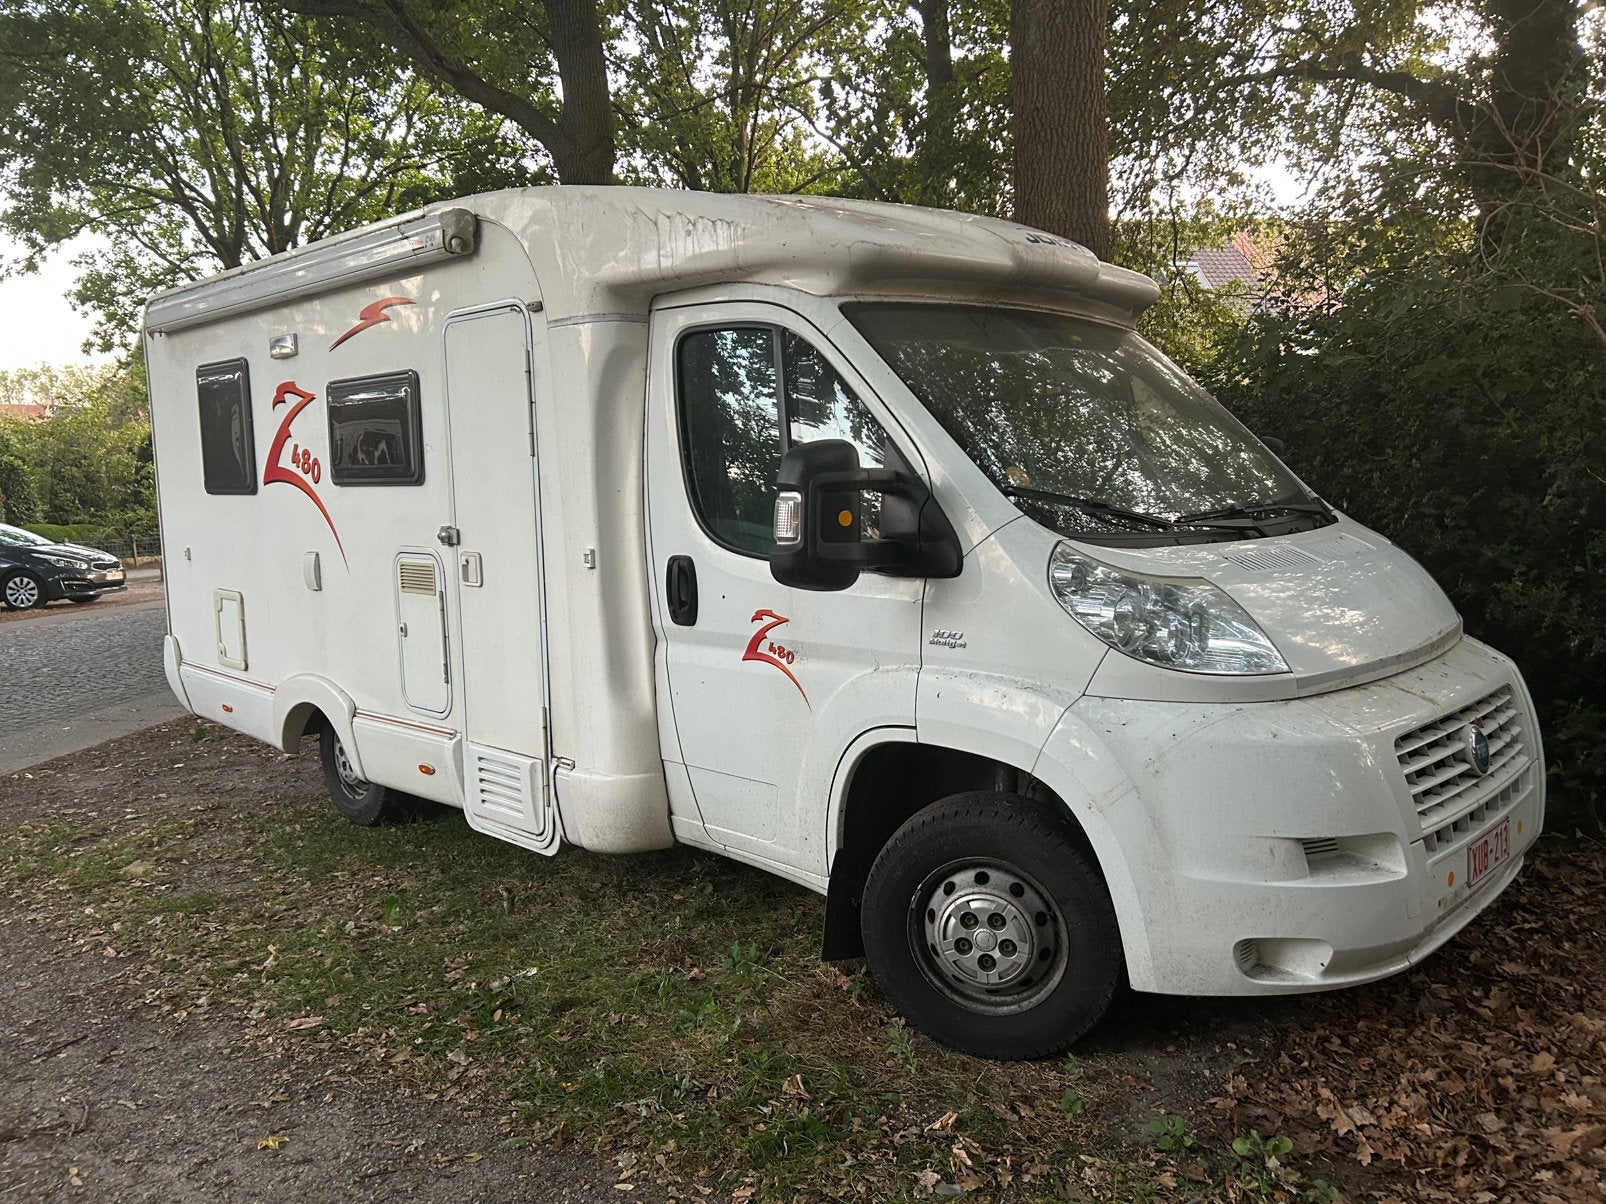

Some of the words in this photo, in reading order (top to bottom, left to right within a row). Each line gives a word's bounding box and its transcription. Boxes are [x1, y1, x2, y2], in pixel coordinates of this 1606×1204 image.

[291, 443, 321, 484] 480
[933, 629, 964, 640] 100
[769, 642, 795, 665] 480
[1472, 825, 1508, 881] XUB-213
